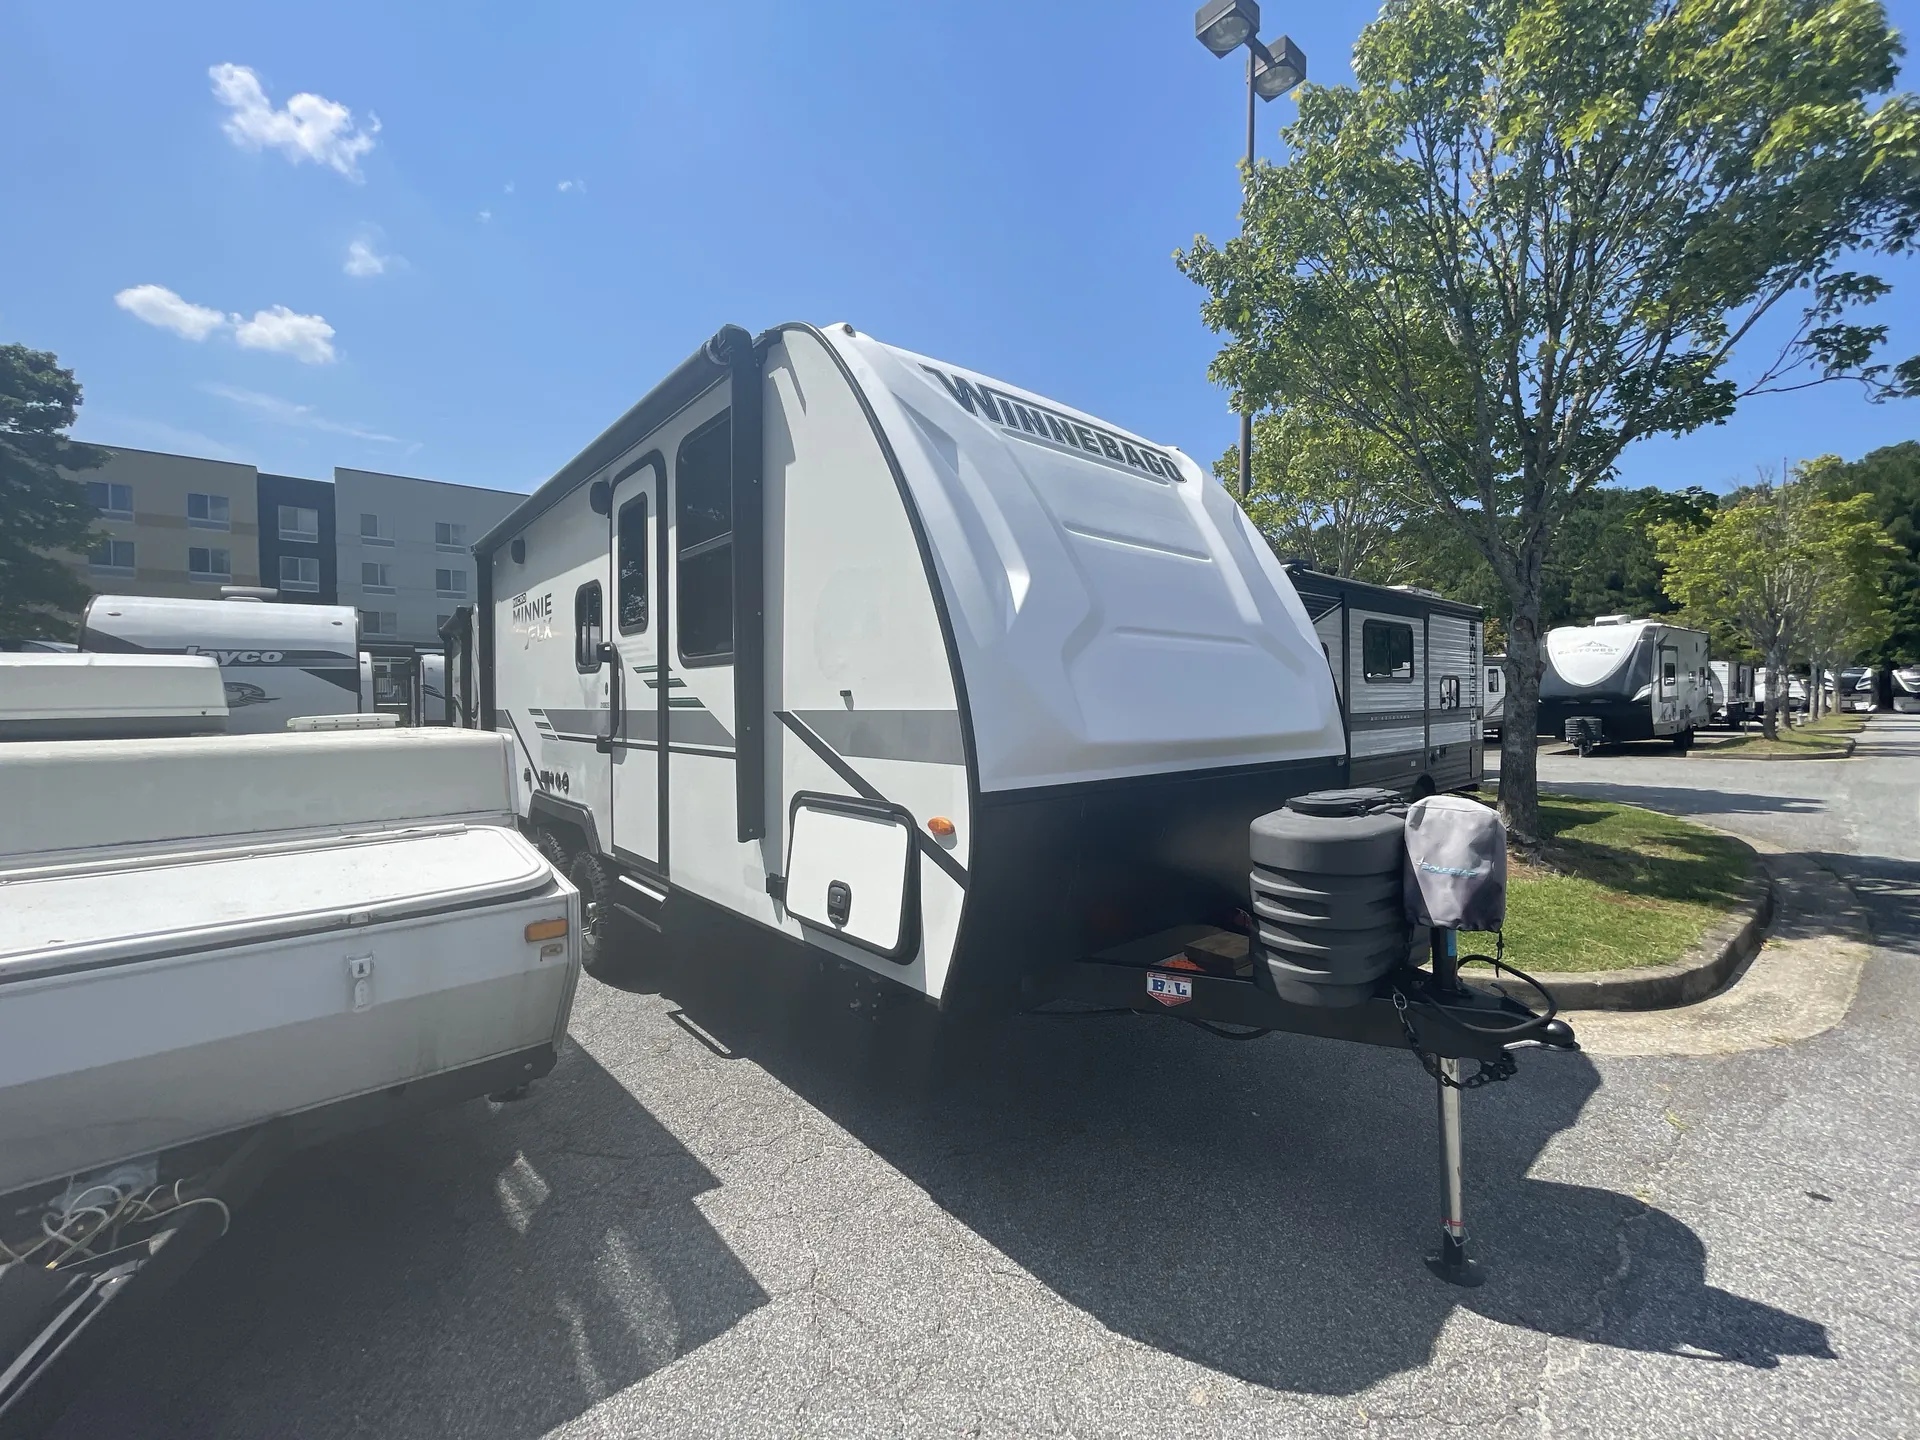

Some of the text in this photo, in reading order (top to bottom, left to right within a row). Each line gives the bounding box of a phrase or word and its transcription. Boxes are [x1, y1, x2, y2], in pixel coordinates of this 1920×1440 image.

[918, 363, 1187, 483] WINNEBAGO
[512, 592, 552, 626] MINNIE
[1152, 979, 1187, 996] BAL
